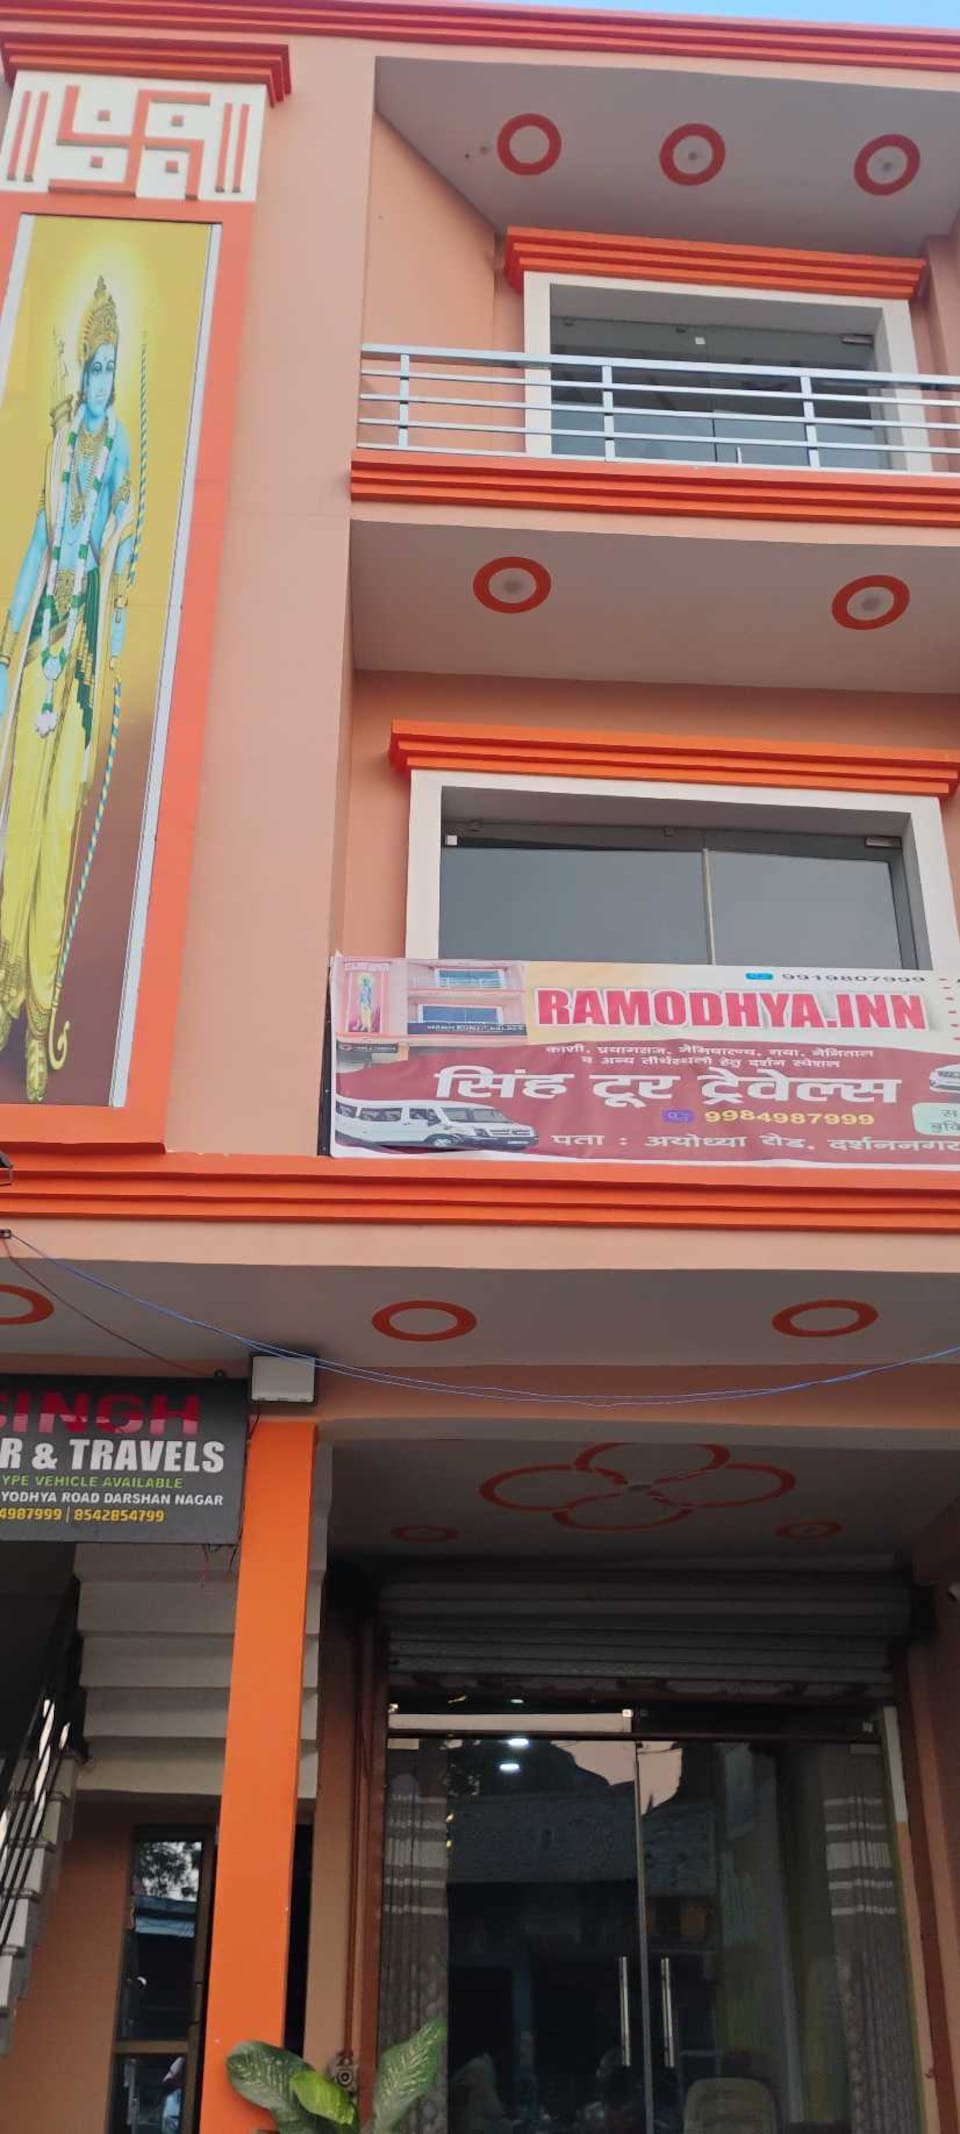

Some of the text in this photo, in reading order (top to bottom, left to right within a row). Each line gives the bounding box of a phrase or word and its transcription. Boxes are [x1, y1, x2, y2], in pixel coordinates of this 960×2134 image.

[781, 972, 926, 983] 9919807999
[537, 988, 927, 1030] RAMODHYA.INN
[434, 1065, 902, 1108] सिंह टूर ट्रेवेल्स
[704, 1110, 875, 1126] 9984987999
[552, 1135, 606, 1146] पता
[644, 1133, 747, 1148] अयोध्या
[0, 1391, 201, 1435] INGH
[32, 1442, 58, 1470] &
[70, 1439, 225, 1473] TRAVELS
[35, 1475, 98, 1487] VEHICLE
[102, 1477, 184, 1489] AVAILABLE
[1, 1491, 224, 1506] YODHYA ROAD DARSHAN NAGAR
[74, 1508, 164, 1522] 8542854799
